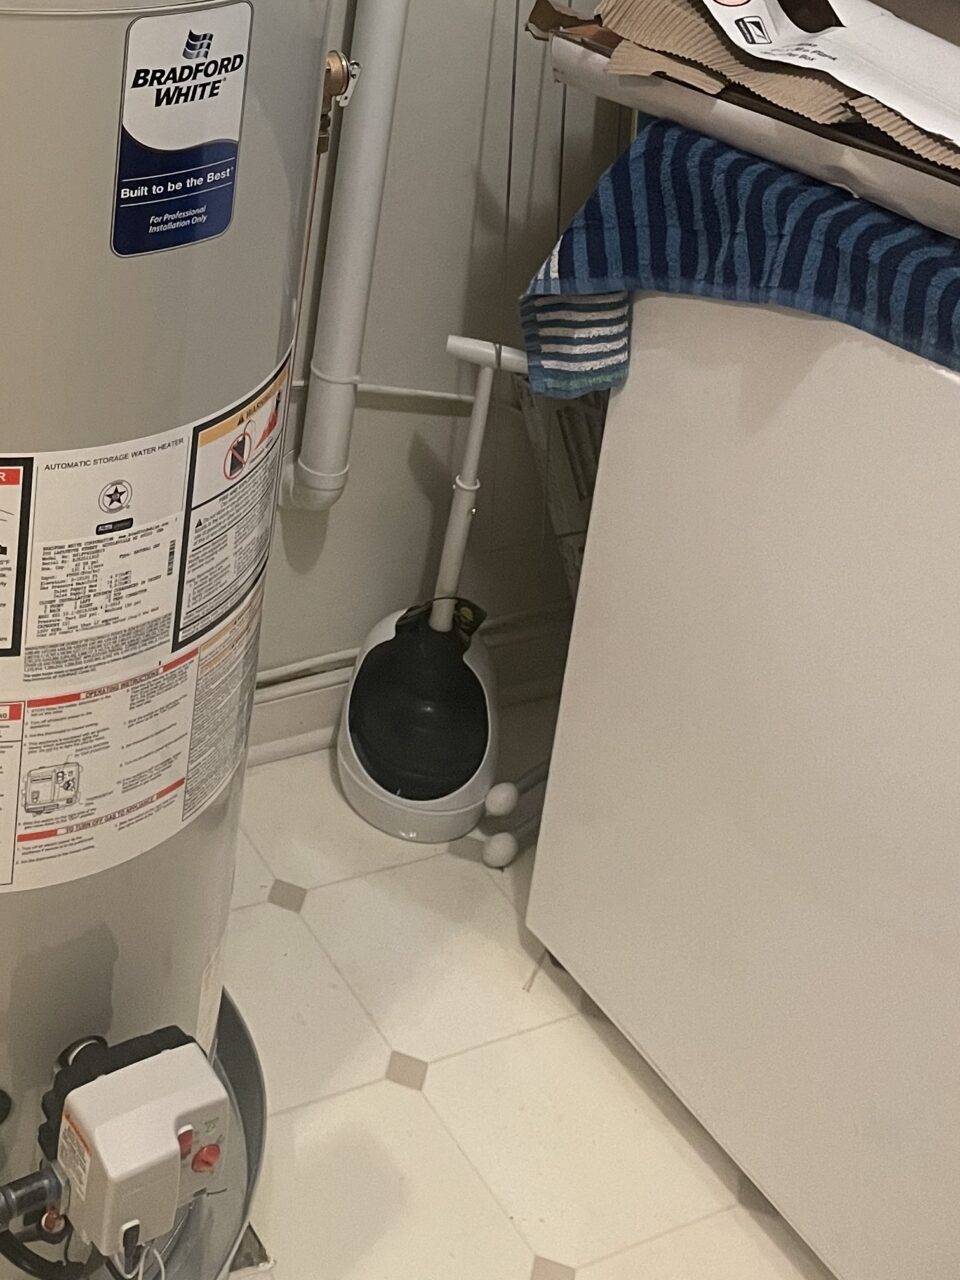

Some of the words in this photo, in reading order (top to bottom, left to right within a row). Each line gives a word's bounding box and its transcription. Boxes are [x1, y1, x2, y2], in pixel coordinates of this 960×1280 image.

[131, 53, 244, 89] BRADFORD
[154, 80, 222, 108] WHITE
[120, 187, 148, 199] Built
[151, 183, 164, 194] to
[167, 180, 183, 193] be
[186, 175, 204, 188] the
[206, 168, 231, 183] Best
[148, 218, 190, 233] Installation
[191, 214, 208, 226] Only
[149, 215, 162, 225] For
[163, 205, 207, 222] Professional
[44, 460, 91, 471] AUTOMATIC
[93, 453, 129, 465] STORAGE
[131, 446, 157, 458] WATER
[158, 437, 184, 451] HEATER
